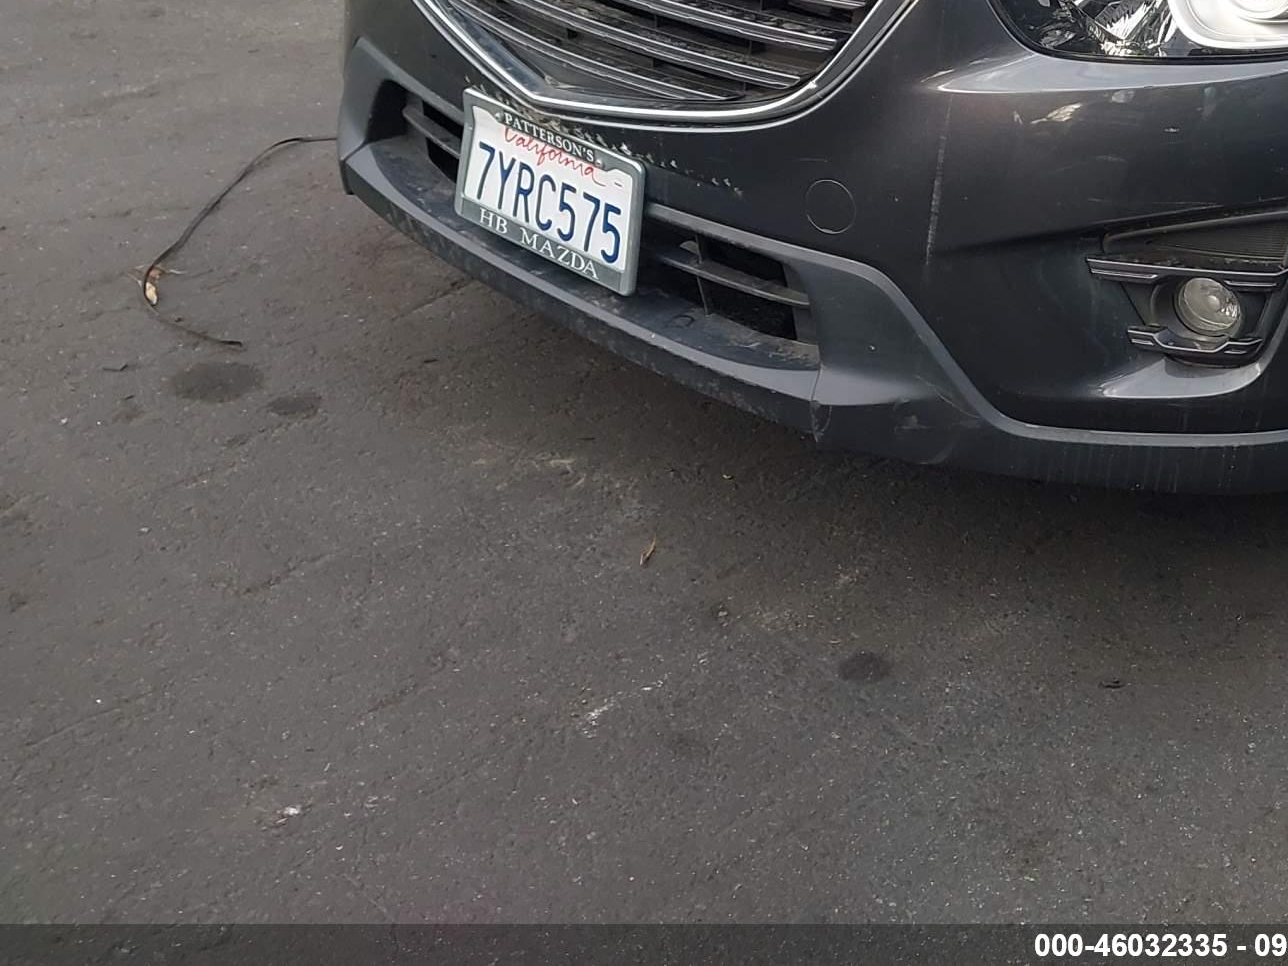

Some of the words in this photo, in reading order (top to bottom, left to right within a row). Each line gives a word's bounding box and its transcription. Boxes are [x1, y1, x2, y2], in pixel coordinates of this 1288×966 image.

[503, 112, 595, 162] PATTERSON'S
[478, 141, 622, 264] 7YRC575
[478, 207, 509, 235] HB
[519, 226, 600, 280] MAZDA
